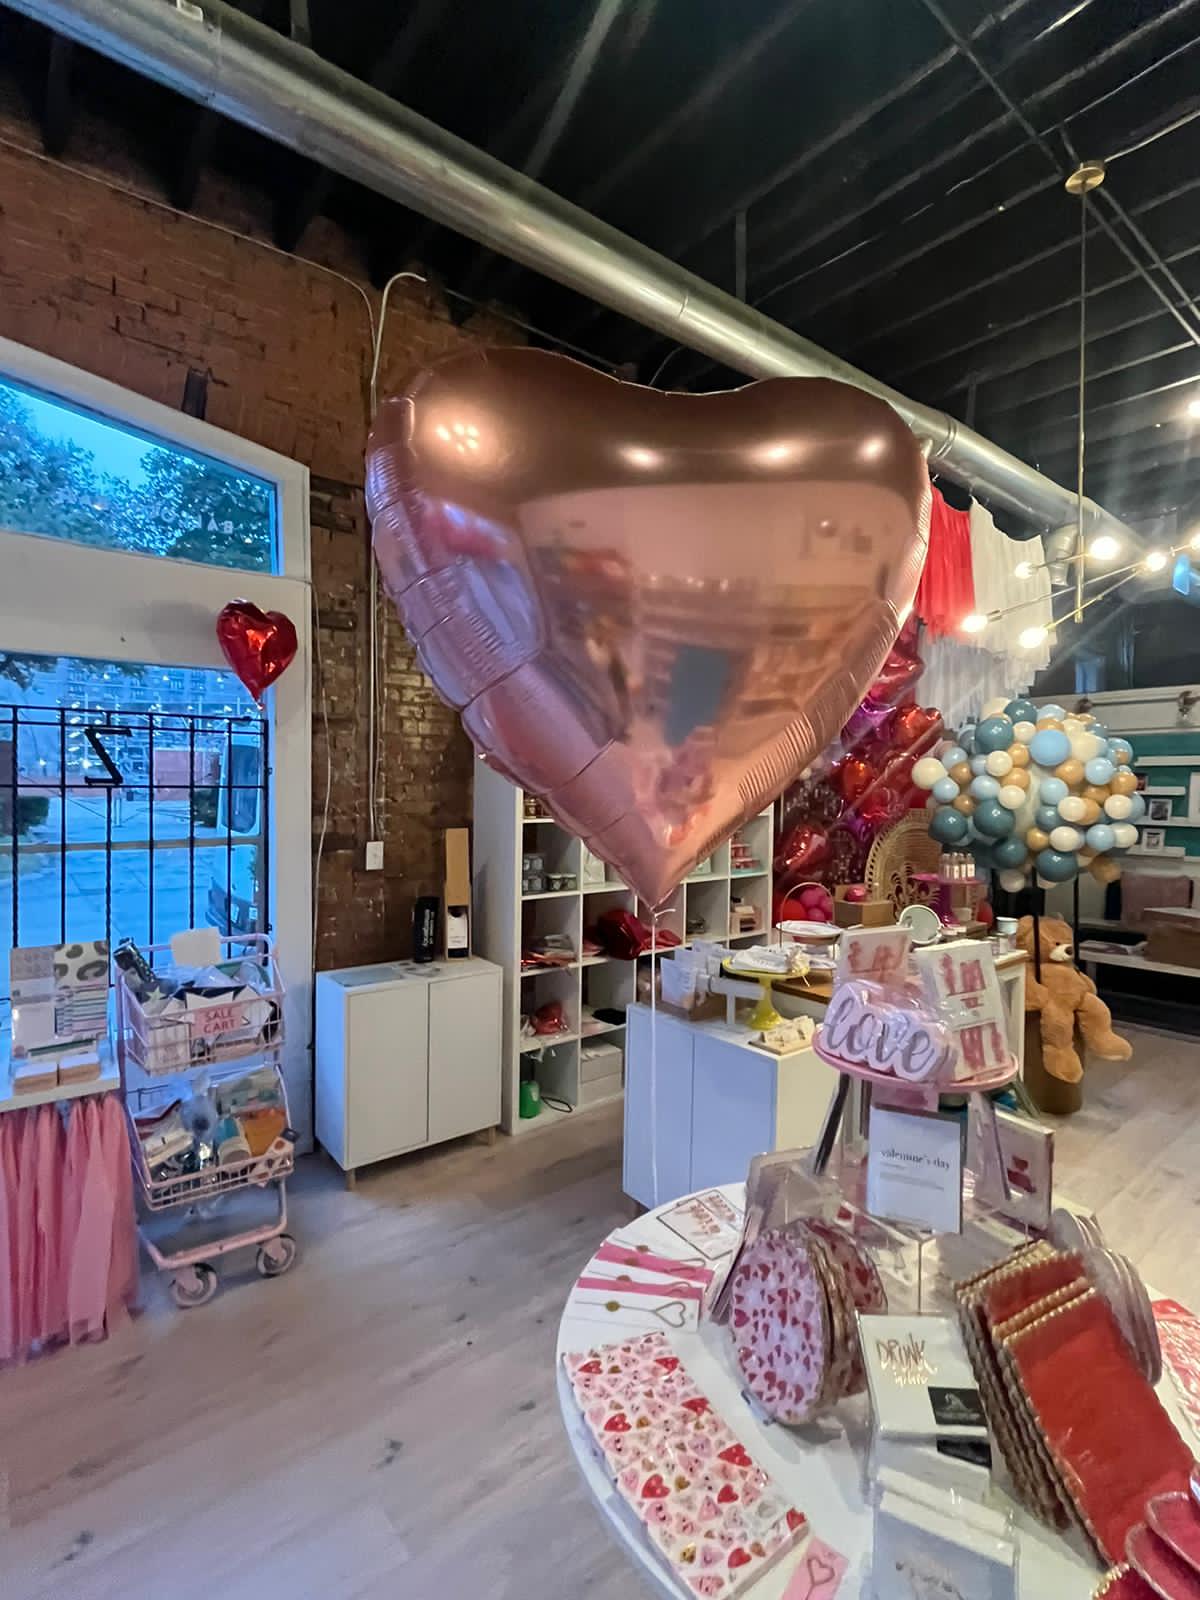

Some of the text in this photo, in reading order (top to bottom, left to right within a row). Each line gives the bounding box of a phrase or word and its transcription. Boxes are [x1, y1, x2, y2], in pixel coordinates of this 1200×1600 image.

[204, 1008, 233, 1022] SALE
[203, 1019, 235, 1033] CART
[825, 995, 936, 1074] love
